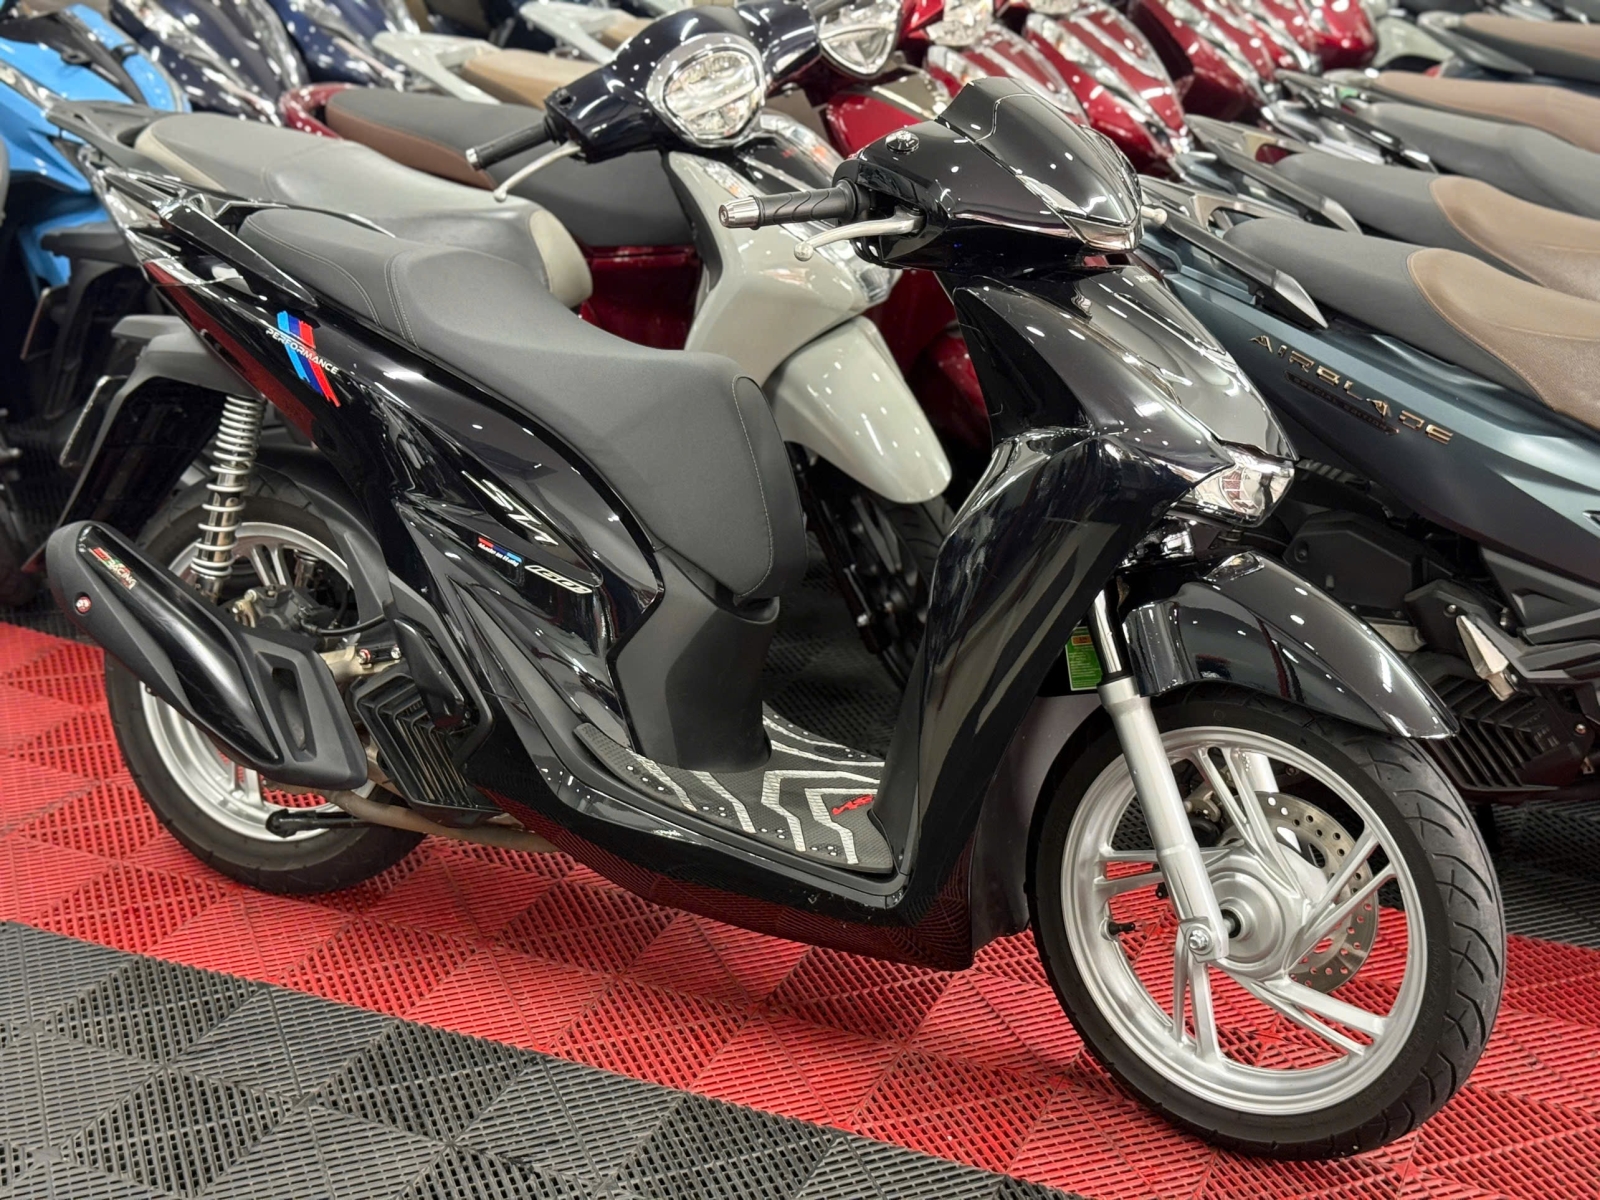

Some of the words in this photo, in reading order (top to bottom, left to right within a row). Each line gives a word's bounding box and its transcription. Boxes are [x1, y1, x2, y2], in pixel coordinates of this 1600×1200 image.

[265, 327, 339, 375] PERFORMANCE
[1292, 376, 1340, 406] SPECIAL
[1342, 403, 1388, 431] EDITION
